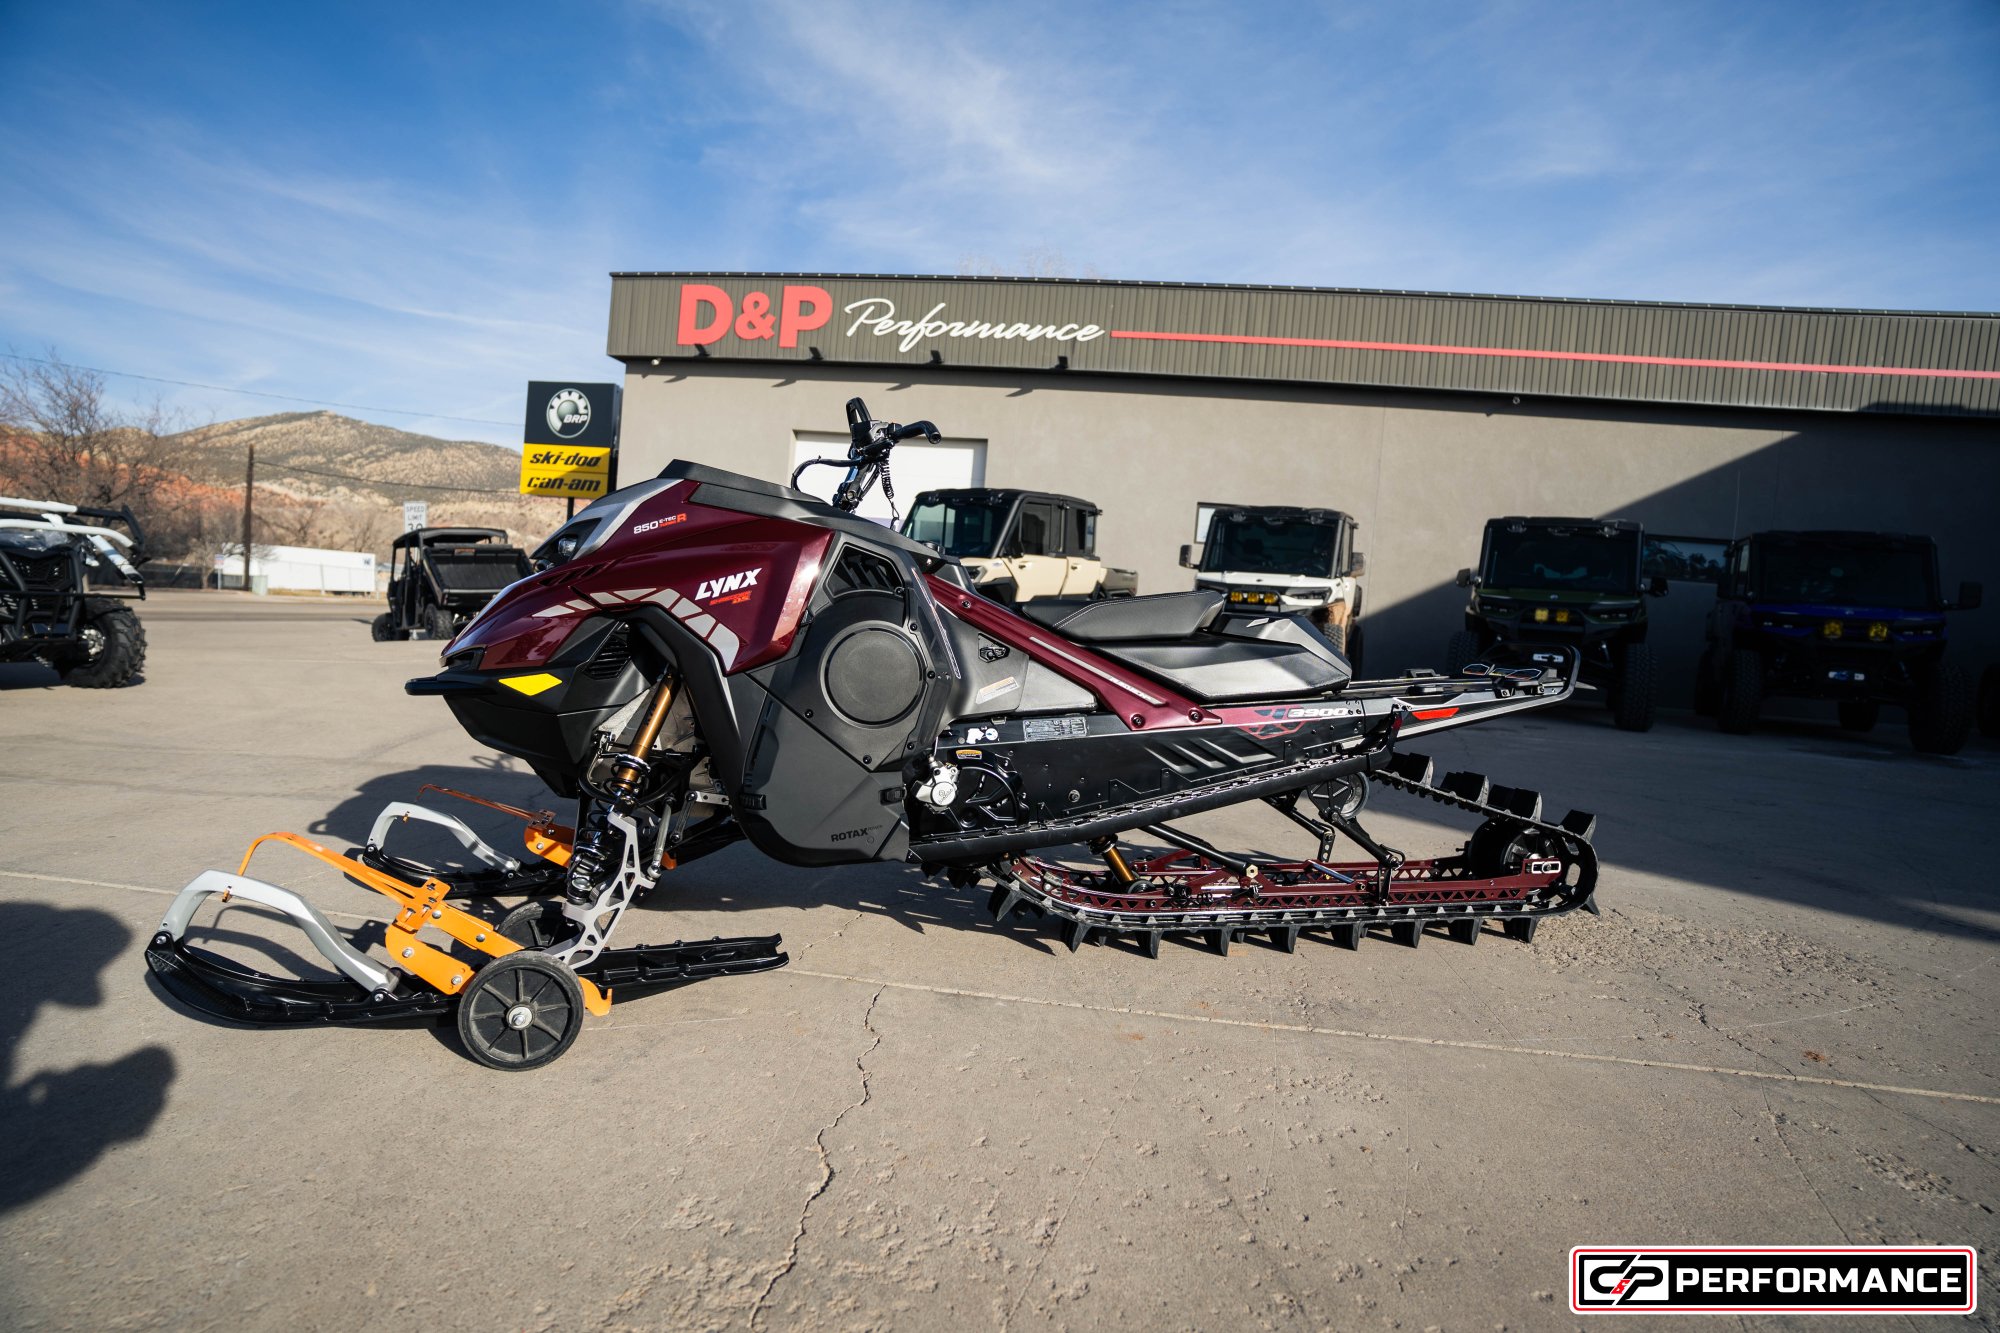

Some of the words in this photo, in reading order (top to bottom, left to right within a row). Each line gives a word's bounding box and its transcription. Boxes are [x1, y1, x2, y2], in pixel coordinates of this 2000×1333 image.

[677, 284, 833, 348] D&P
[844, 298, 1106, 352] Performance
[563, 414, 588, 424] BRP
[530, 451, 601, 467] ski-doo
[527, 477, 601, 492] can-am
[633, 520, 659, 534] 850
[677, 513, 687, 523] R
[695, 568, 762, 600] LYNX
[1287, 708, 1349, 718] 3900
[831, 828, 868, 842] ROTAX
